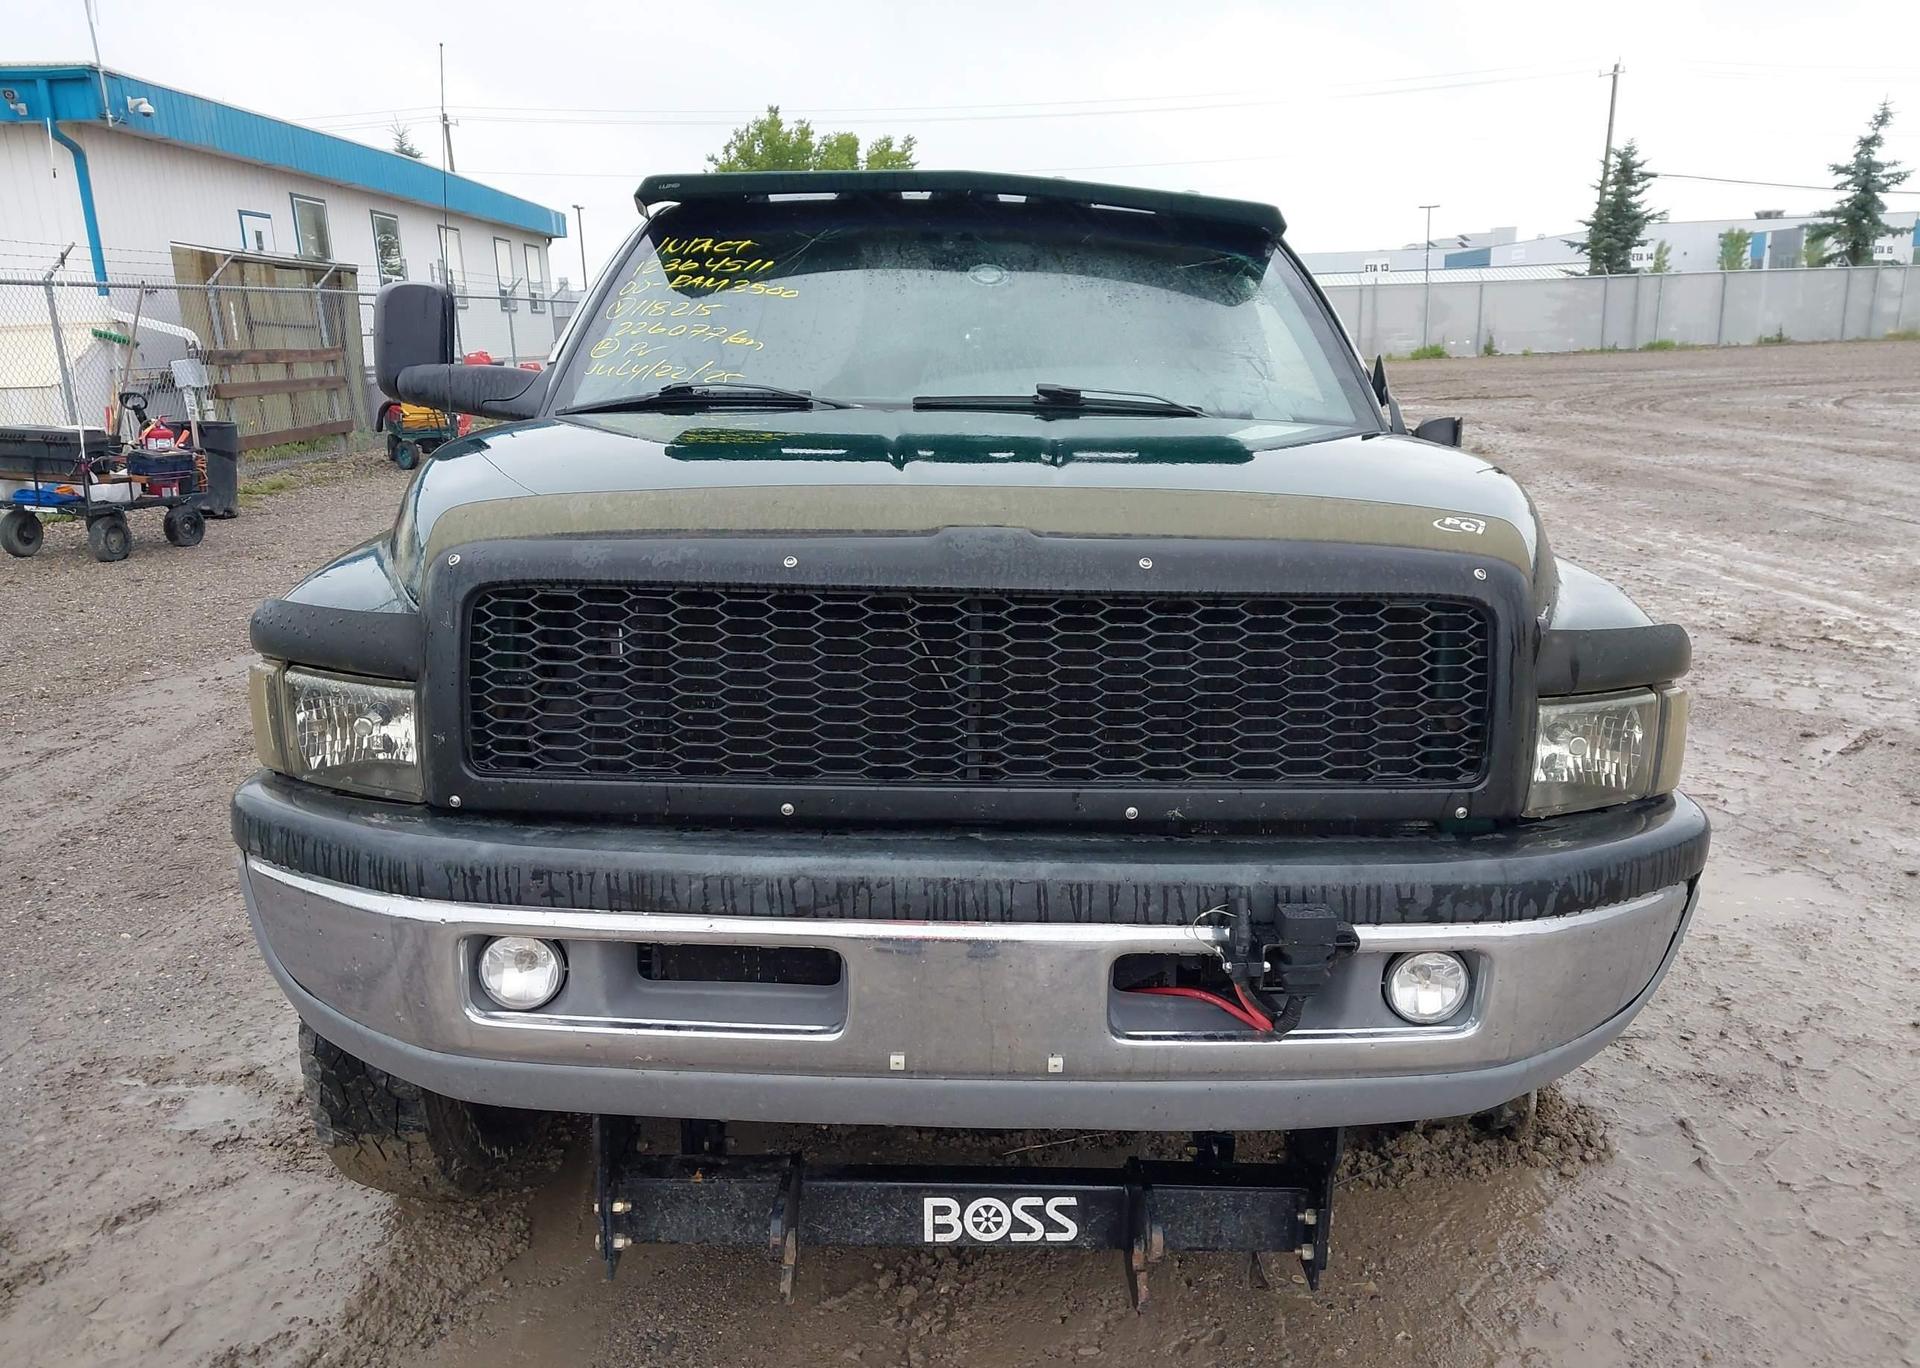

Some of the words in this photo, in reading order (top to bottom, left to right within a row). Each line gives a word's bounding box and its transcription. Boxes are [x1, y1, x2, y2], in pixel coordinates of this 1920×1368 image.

[651, 237, 760, 256] INTACT
[1632, 252, 1643, 261] ETA
[1646, 252, 1654, 261] 14
[1365, 264, 1378, 273] ETA
[1381, 263, 1389, 272] 13
[924, 1196, 1078, 1242] BOSS
